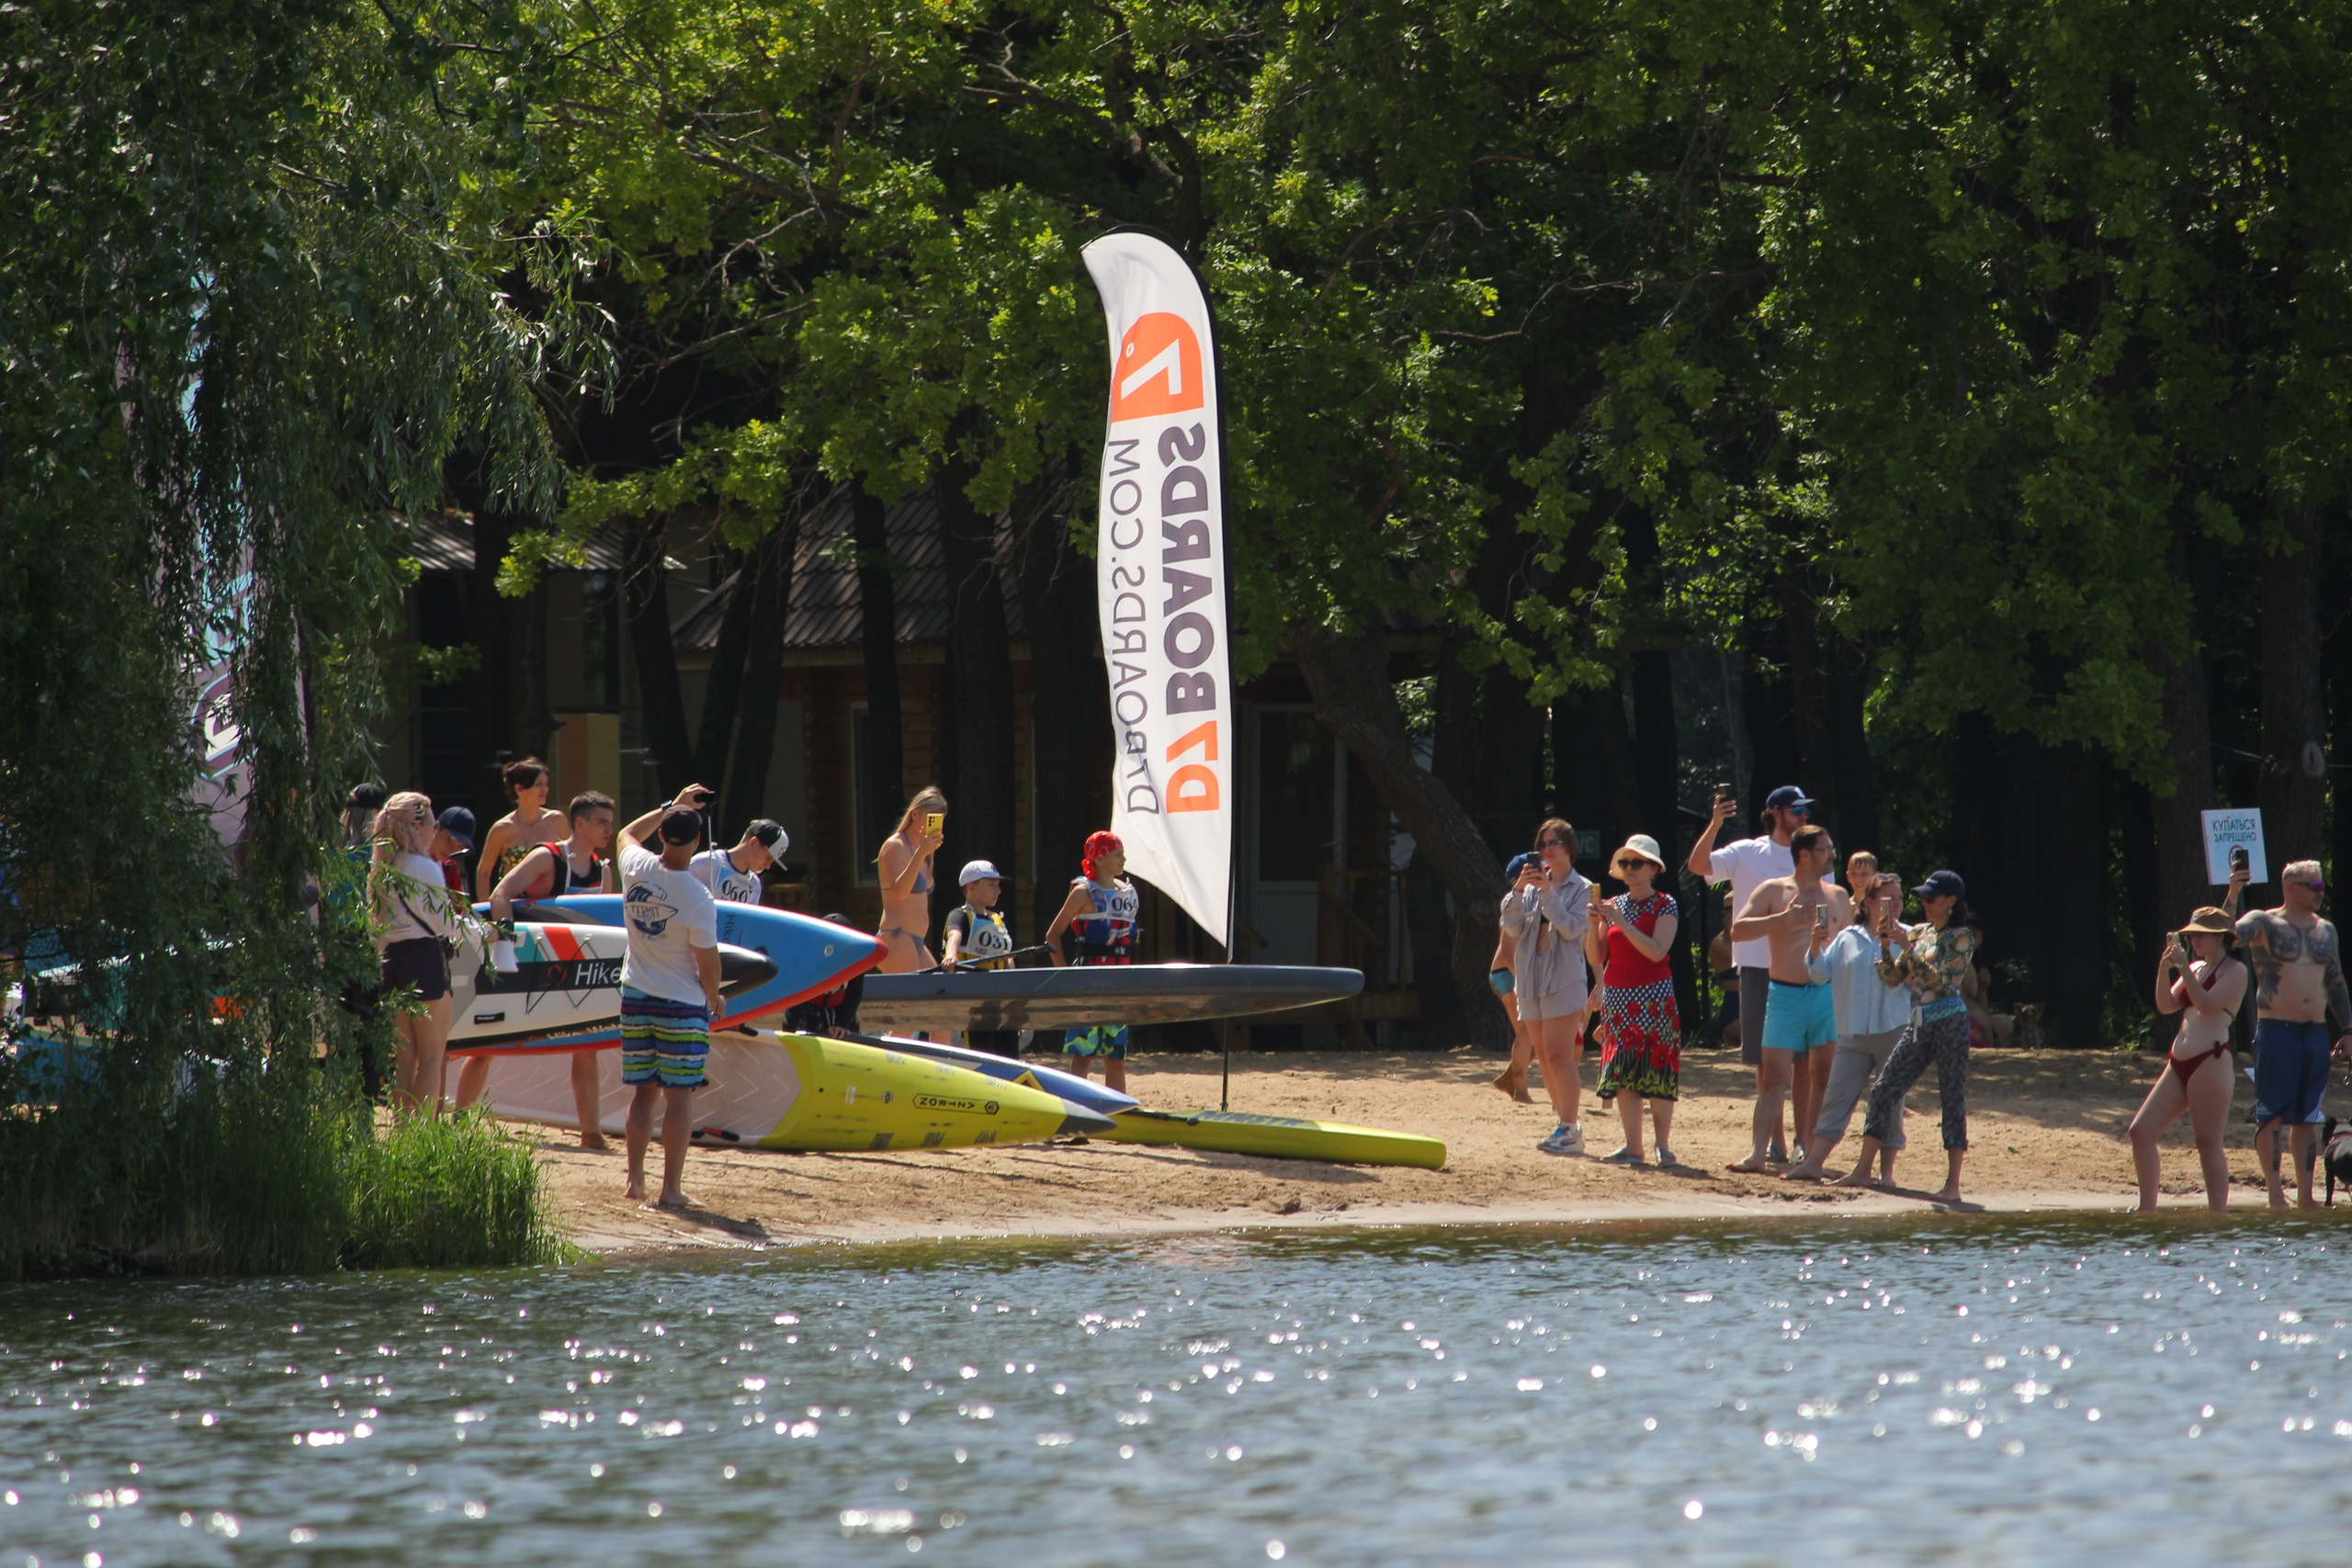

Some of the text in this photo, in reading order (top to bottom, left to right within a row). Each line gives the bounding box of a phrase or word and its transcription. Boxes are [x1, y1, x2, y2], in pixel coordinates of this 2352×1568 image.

[2212, 818, 2256, 831] КУПАТЬСЯ
[2214, 831, 2256, 842] ЗАПРЕЩЕНО
[574, 962, 622, 986] Hike
[920, 1097, 976, 1110] AZTRON
